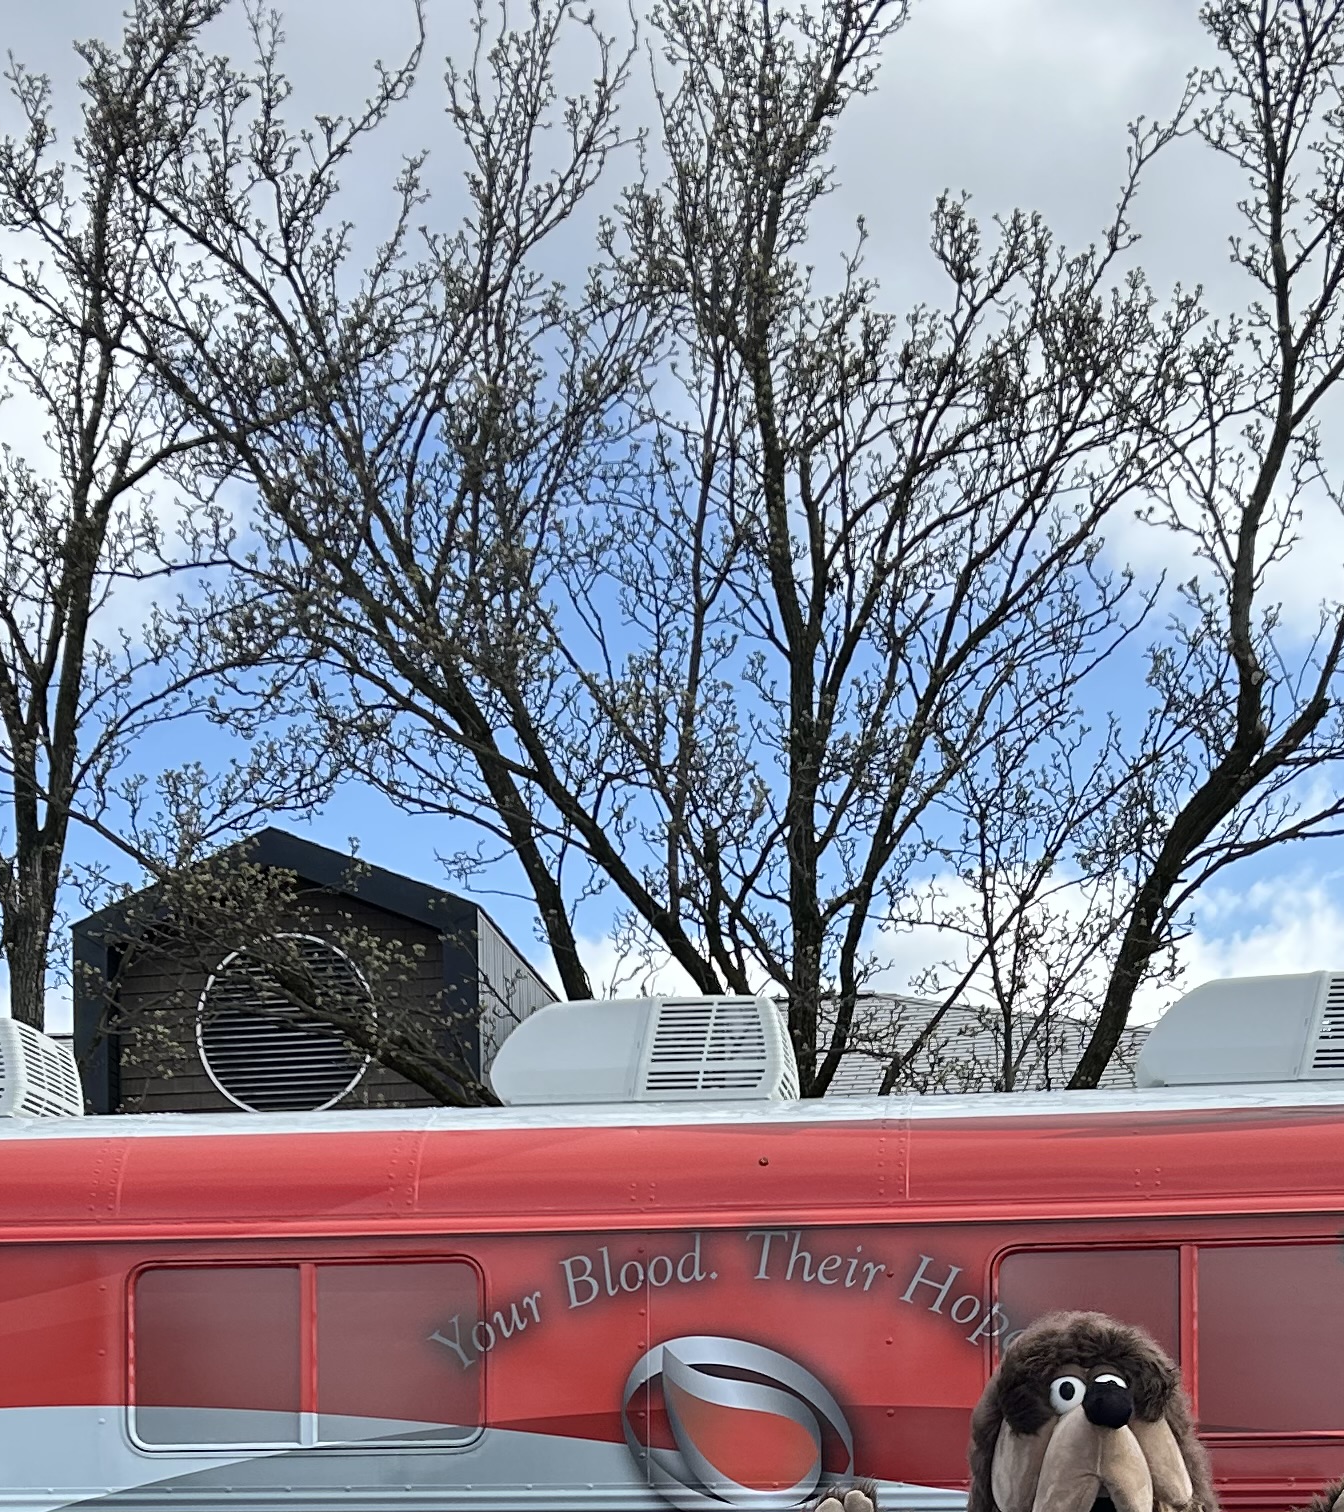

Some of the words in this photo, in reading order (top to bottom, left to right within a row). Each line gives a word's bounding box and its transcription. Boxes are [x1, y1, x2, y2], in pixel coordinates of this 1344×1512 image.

[427, 1289, 545, 1371] Your
[559, 1232, 718, 1310] Blood.
[745, 1230, 887, 1292] Their
